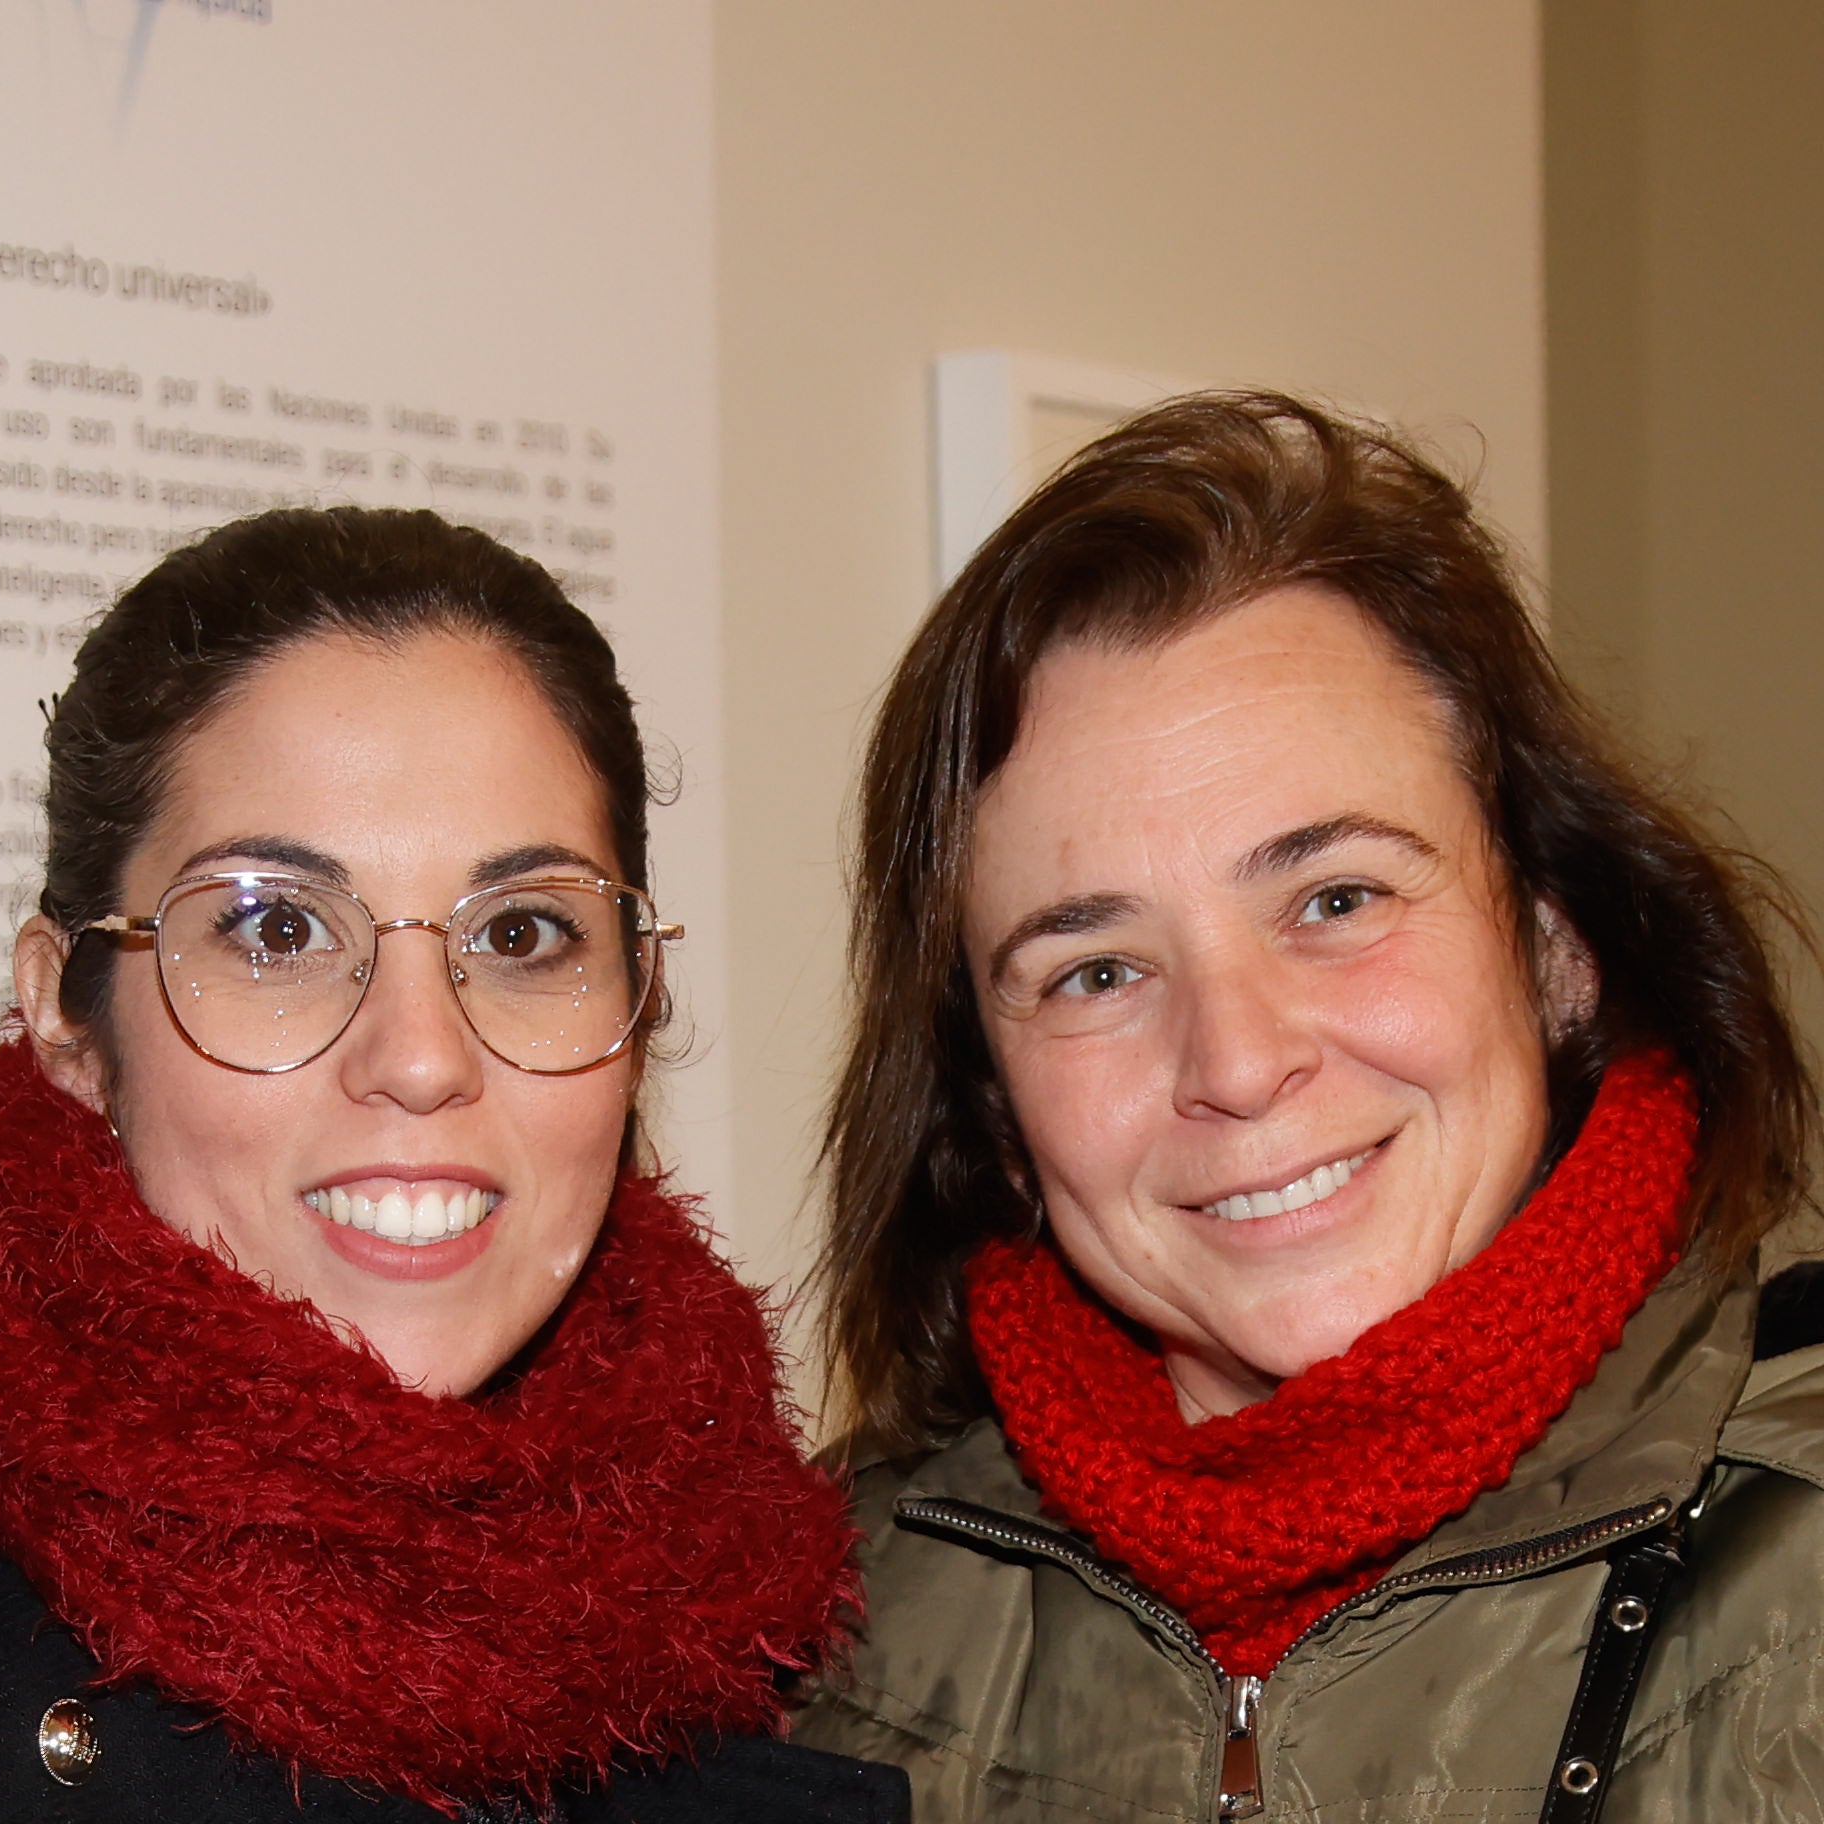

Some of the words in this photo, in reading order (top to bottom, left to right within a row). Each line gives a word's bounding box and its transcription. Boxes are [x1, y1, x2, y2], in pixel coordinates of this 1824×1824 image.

[116, 259, 271, 315] universal»
[30, 359, 142, 399] aprobada
[159, 376, 197, 407] por
[270, 386, 370, 429] Naciones
[2, 410, 48, 439] uso
[71, 415, 114, 444] son
[135, 415, 304, 471] fundamentales
[55, 460, 122, 498] desde
[131, 467, 152, 503] la
[89, 523, 141, 555] pero
[35, 625, 48, 655] y
